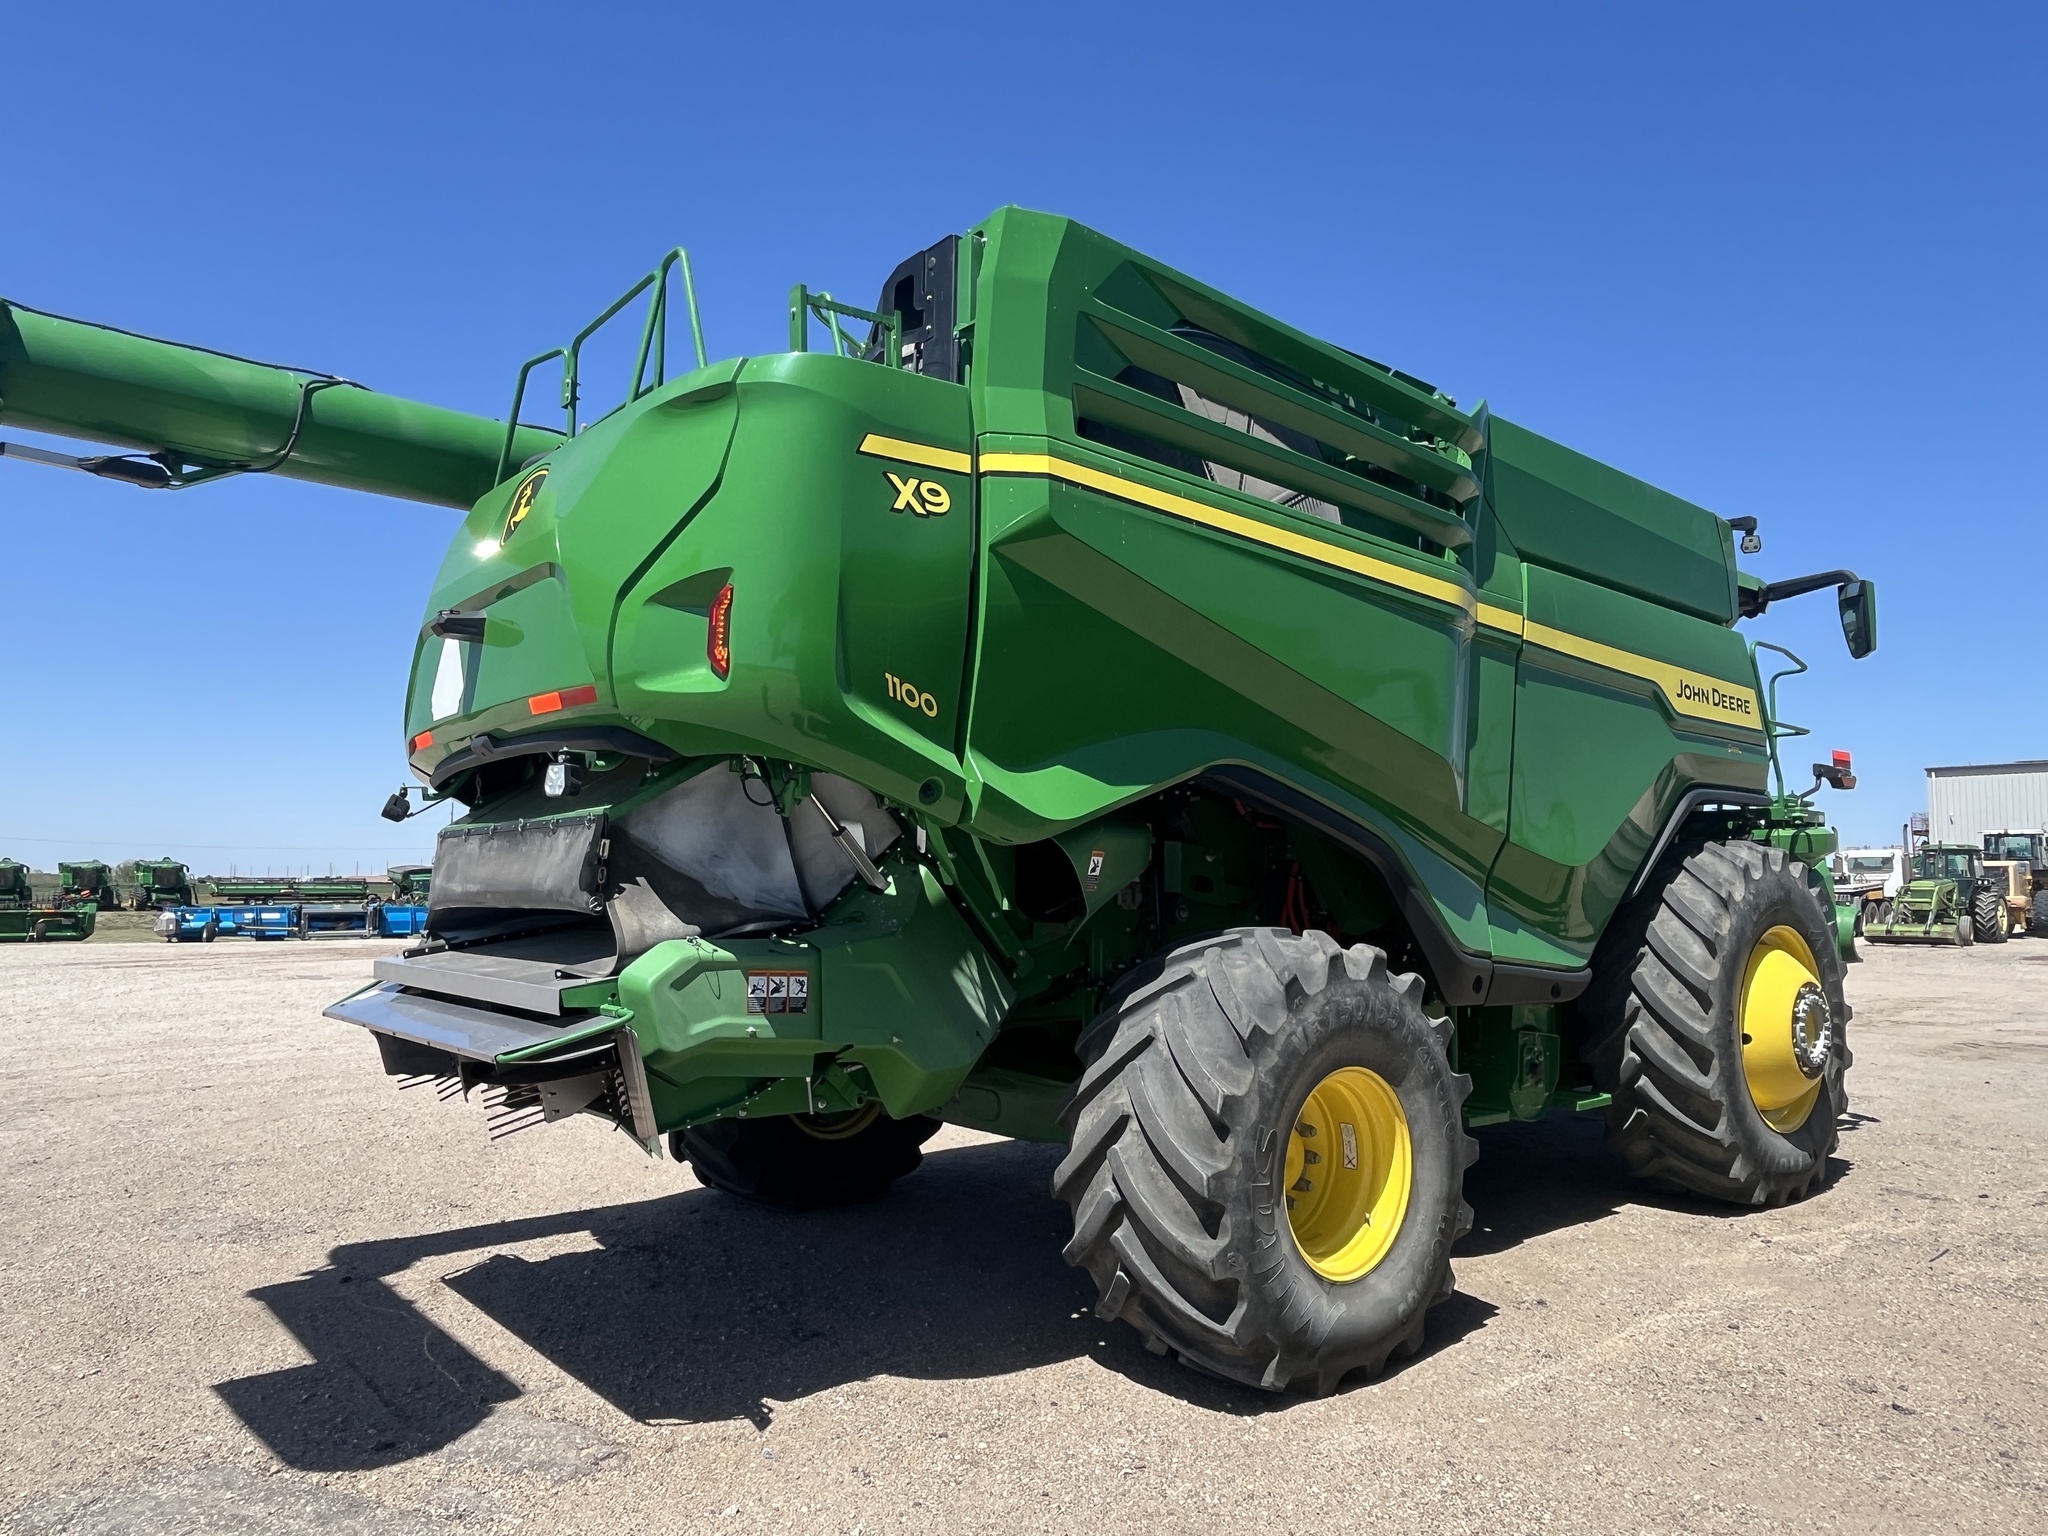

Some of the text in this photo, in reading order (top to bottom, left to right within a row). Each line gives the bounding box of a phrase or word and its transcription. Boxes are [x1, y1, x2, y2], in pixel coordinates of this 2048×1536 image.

[883, 471, 951, 517] X9
[885, 672, 938, 718] 1100
[1676, 679, 1751, 715] JOHN DEERE
